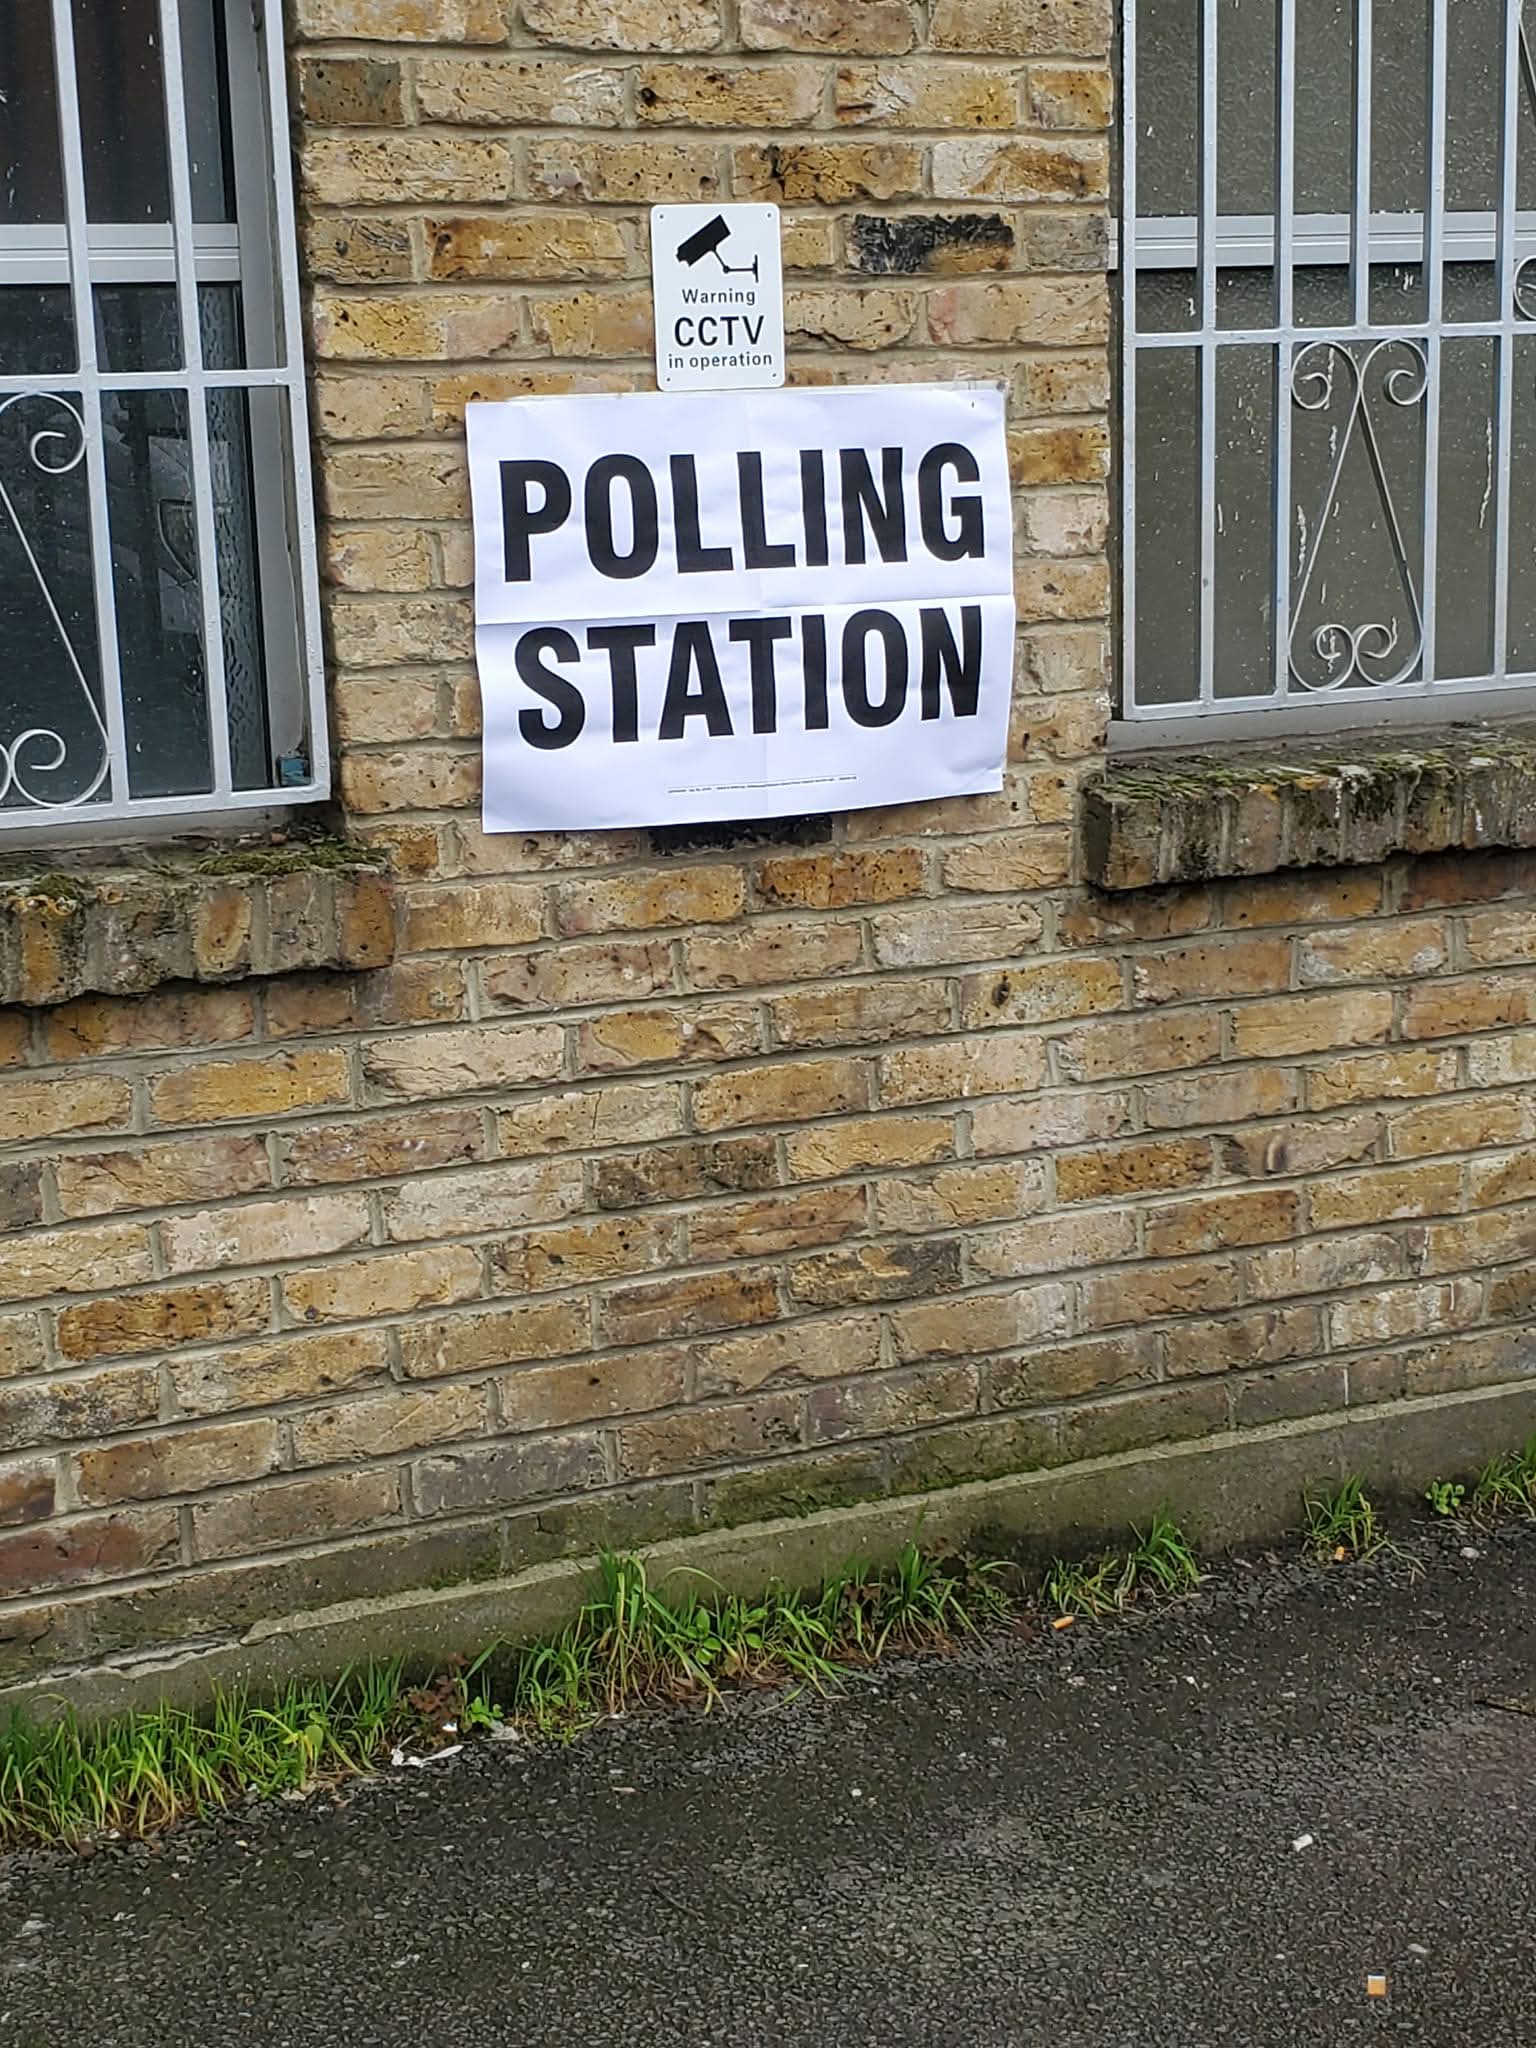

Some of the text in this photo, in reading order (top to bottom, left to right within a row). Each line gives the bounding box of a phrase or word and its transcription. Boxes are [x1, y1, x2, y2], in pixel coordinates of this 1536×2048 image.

[681, 288, 756, 306] Warning
[674, 315, 765, 347] CCTV
[668, 351, 773, 371] in operation
[499, 442, 985, 582] POLLING
[515, 605, 982, 750] STATION
